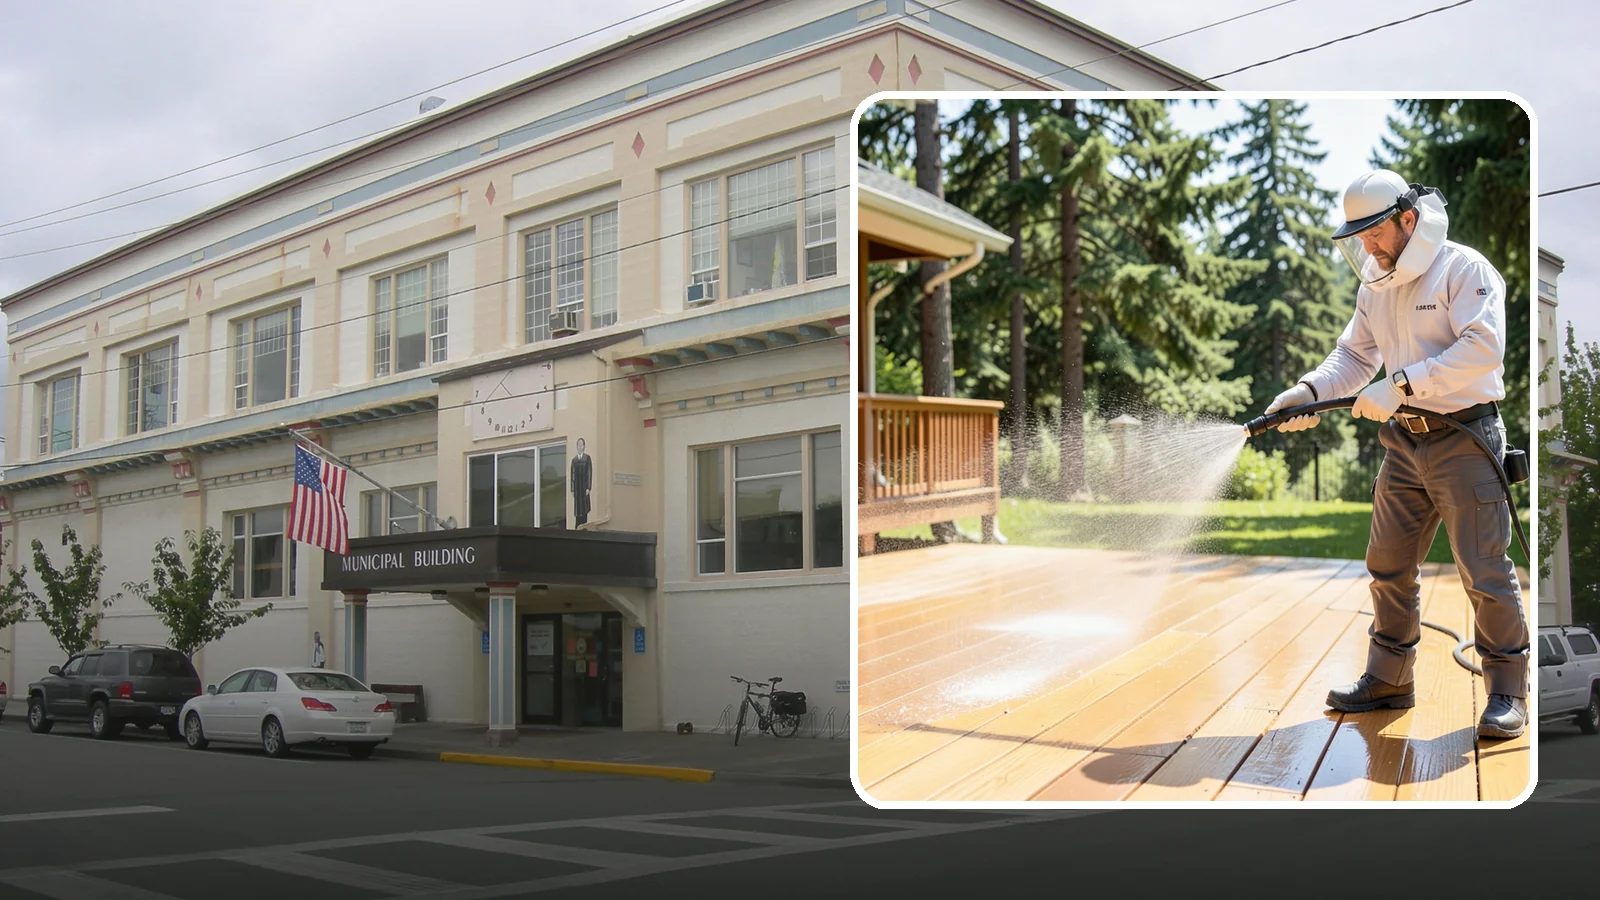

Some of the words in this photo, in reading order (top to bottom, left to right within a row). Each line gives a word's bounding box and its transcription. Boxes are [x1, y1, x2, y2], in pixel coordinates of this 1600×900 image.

[480, 407, 485, 415] 8
[487, 418, 492, 426] 9
[521, 420, 526, 428] 2
[494, 423, 500, 432] 10
[507, 425, 514, 433] 12
[342, 552, 405, 572] MUNICIPAL
[414, 546, 475, 567] BUILDING
